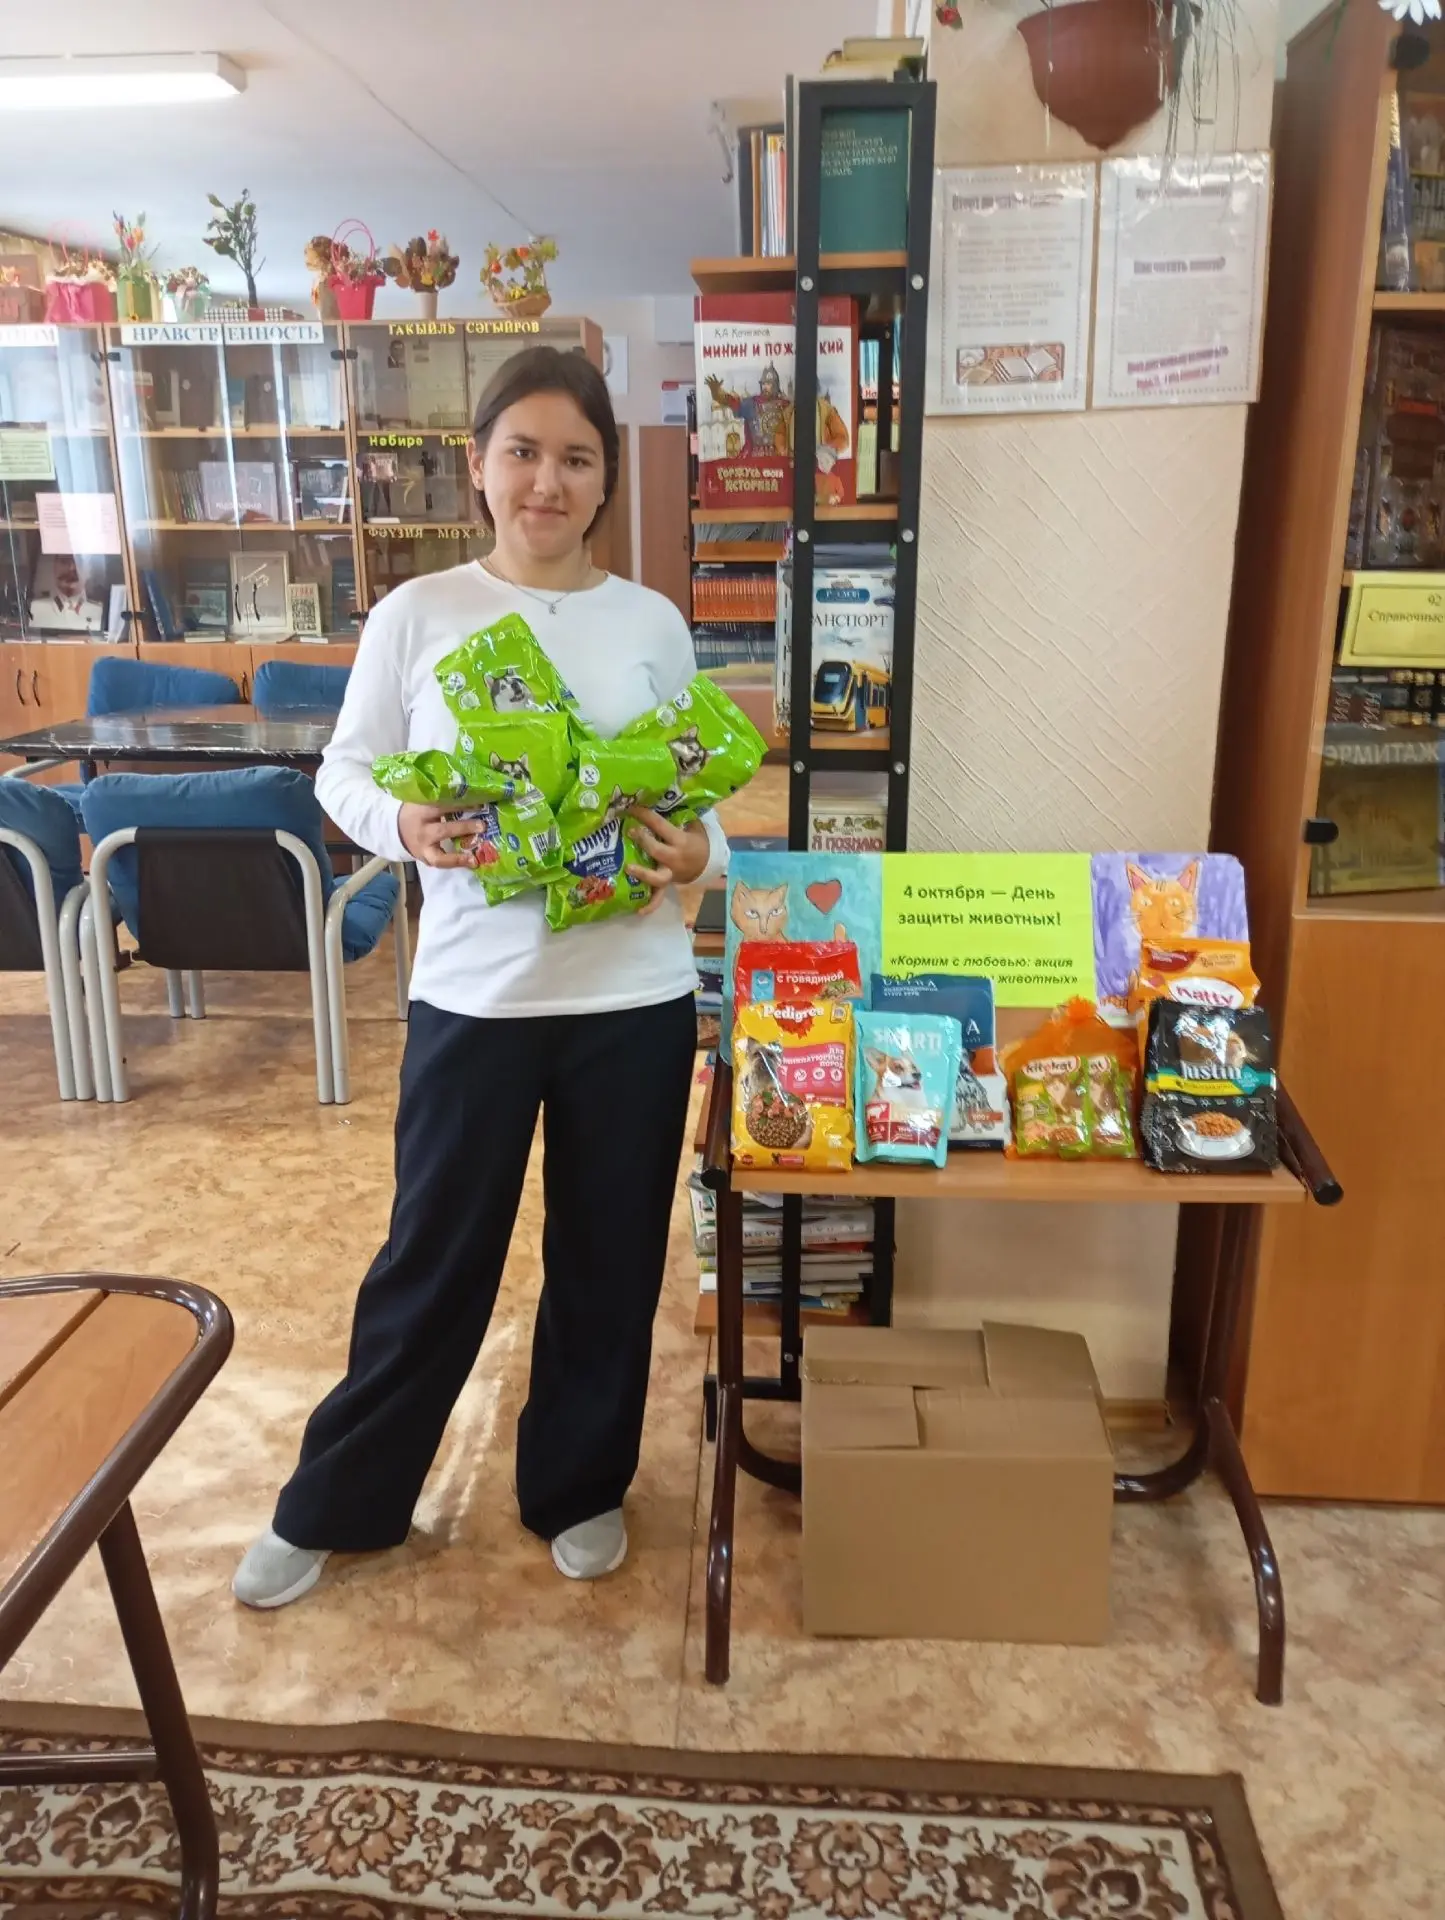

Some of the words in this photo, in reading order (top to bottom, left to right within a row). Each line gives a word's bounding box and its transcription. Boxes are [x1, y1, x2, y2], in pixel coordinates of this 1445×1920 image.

[132, 325, 320, 342] НРАВСТВЕННОСТЬ
[703, 343, 748, 358] МИНИН
[752, 344, 761, 356] И
[765, 338, 844, 357] ПОЖКИЙ
[1367, 609, 1445, 624] Справочные
[1324, 741, 1439, 767] ЭРМИТАЖ
[903, 885, 913, 899] 4
[917, 887, 985, 902] октября
[1012, 886, 1056, 902] День
[898, 912, 964, 927] защиты
[968, 911, 1062, 926] животных!
[890, 955, 949, 968] «Кормим
[952, 958, 960, 967] с
[963, 956, 1030, 968] любовью:
[1034, 958, 1073, 968] акция
[997, 973, 1078, 984] животных»
[763, 1003, 825, 1023] Pedigree
